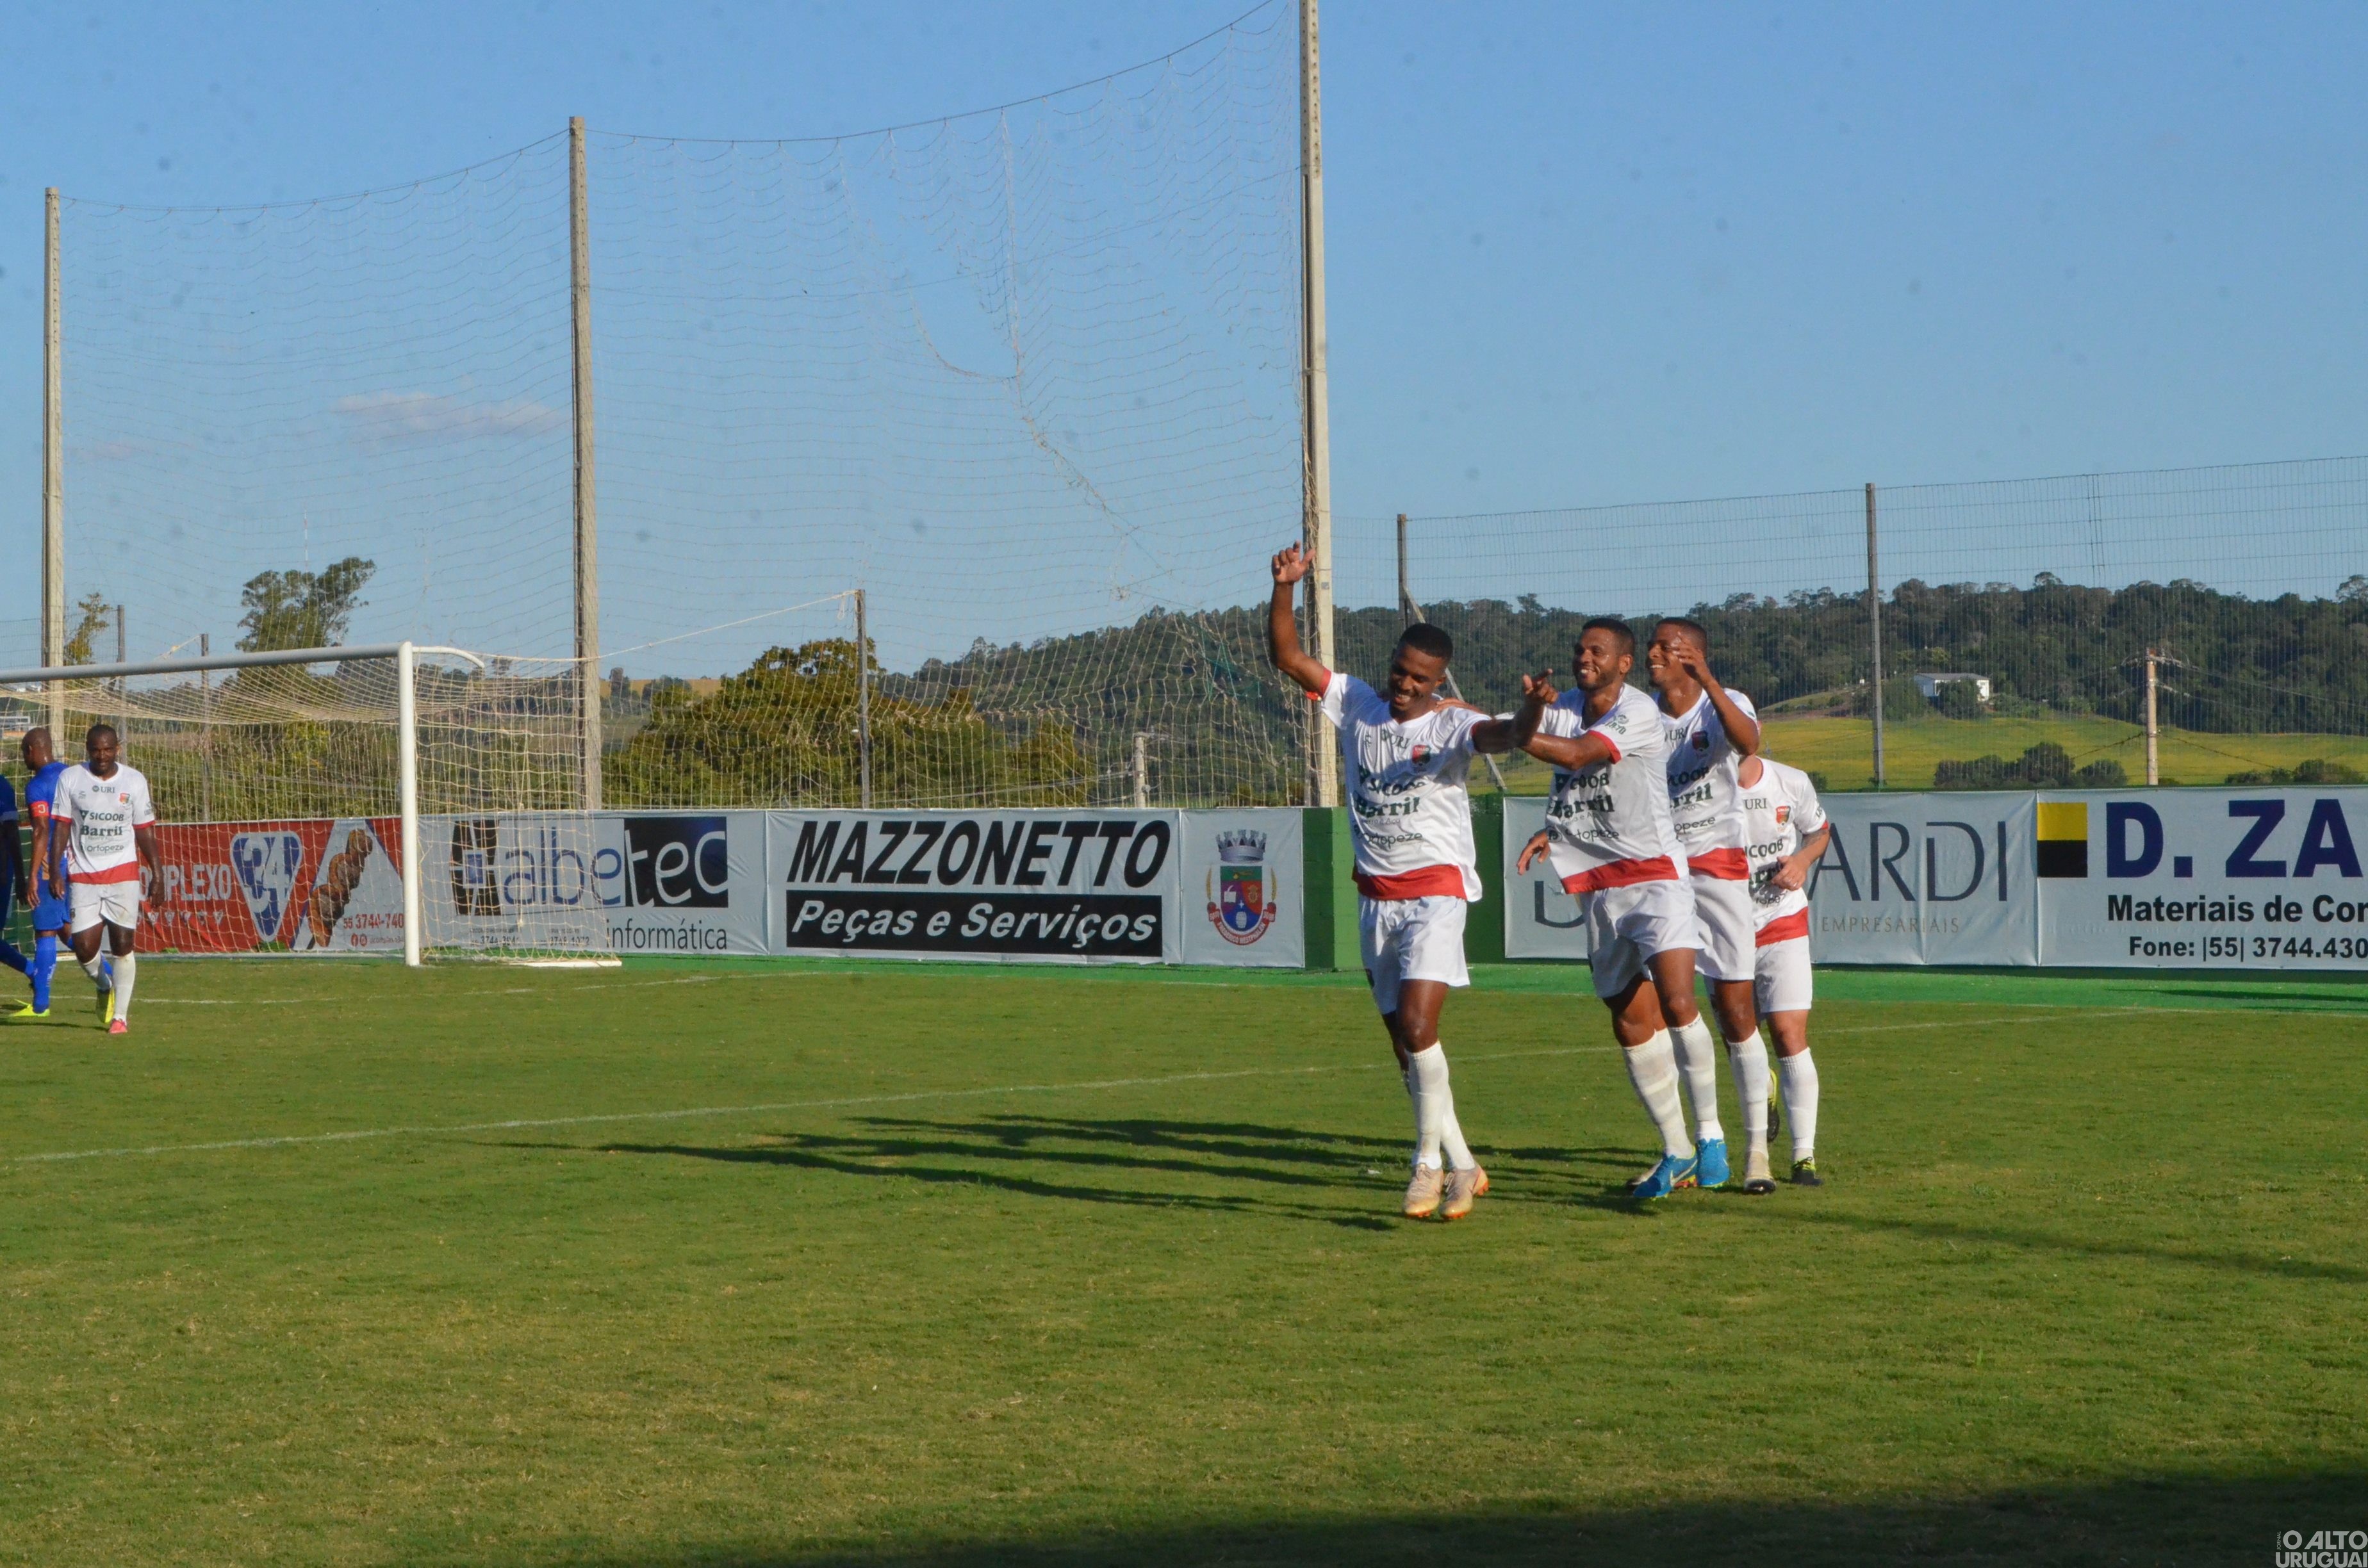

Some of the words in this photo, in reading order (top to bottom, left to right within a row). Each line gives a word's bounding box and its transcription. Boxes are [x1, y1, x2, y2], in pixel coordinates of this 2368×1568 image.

[1745, 798, 1768, 810] URI
[90, 812, 124, 821] SICOOB
[81, 825, 123, 836] Barril
[2106, 801, 2193, 878] D.
[2225, 798, 2364, 878] ZA
[786, 820, 1171, 888] MAZZONETTO
[2107, 894, 2255, 922] Materiais
[2264, 894, 2303, 922] de
[606, 918, 727, 951] informática
[791, 899, 917, 943] Peças
[926, 910, 951, 936] e
[960, 902, 1157, 949] Serviços
[1822, 916, 1959, 933] EMPRESARIAIS
[2129, 936, 2195, 957] Fone:
